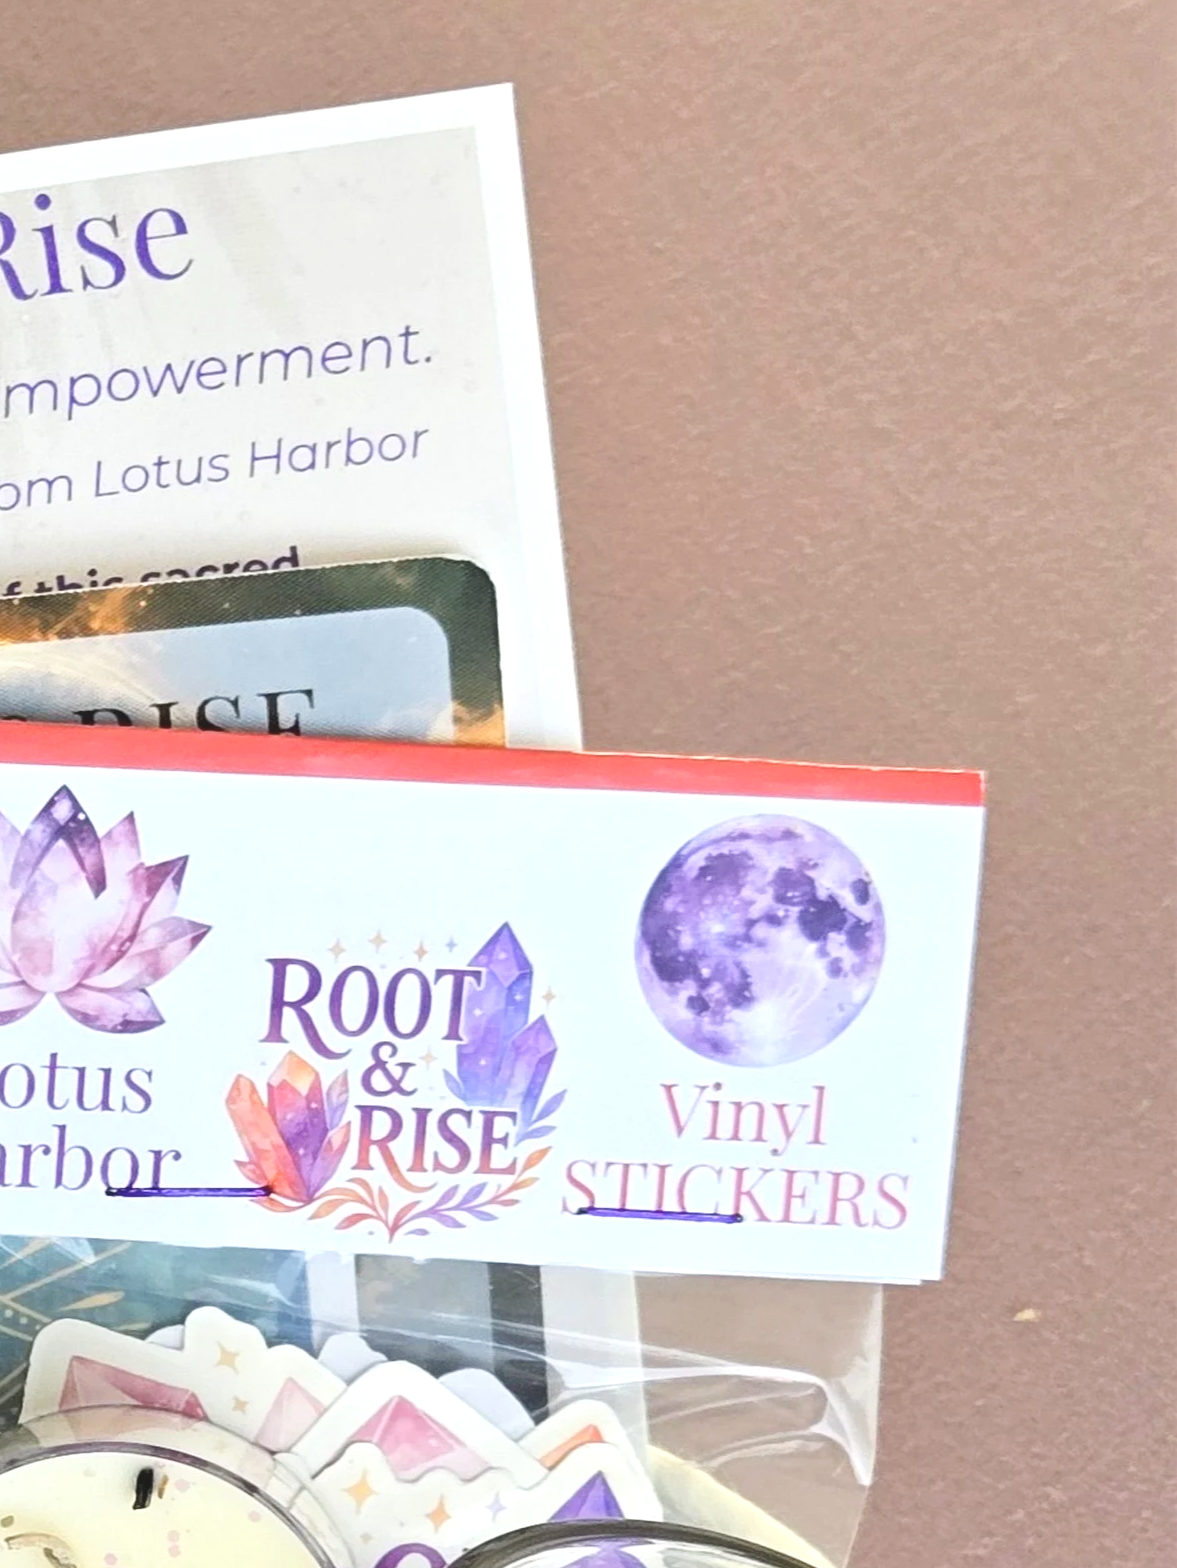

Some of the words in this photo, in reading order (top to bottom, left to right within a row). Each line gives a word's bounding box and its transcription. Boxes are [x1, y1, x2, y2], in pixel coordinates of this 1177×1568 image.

[94, 449, 230, 498] Lotus
[249, 426, 429, 479] Harbor
[258, 957, 482, 1060] ROOT
[360, 1040, 418, 1098] &
[350, 1104, 518, 1193] RISE
[660, 1081, 827, 1157] Vinyl
[561, 1158, 909, 1230] STICKERS
